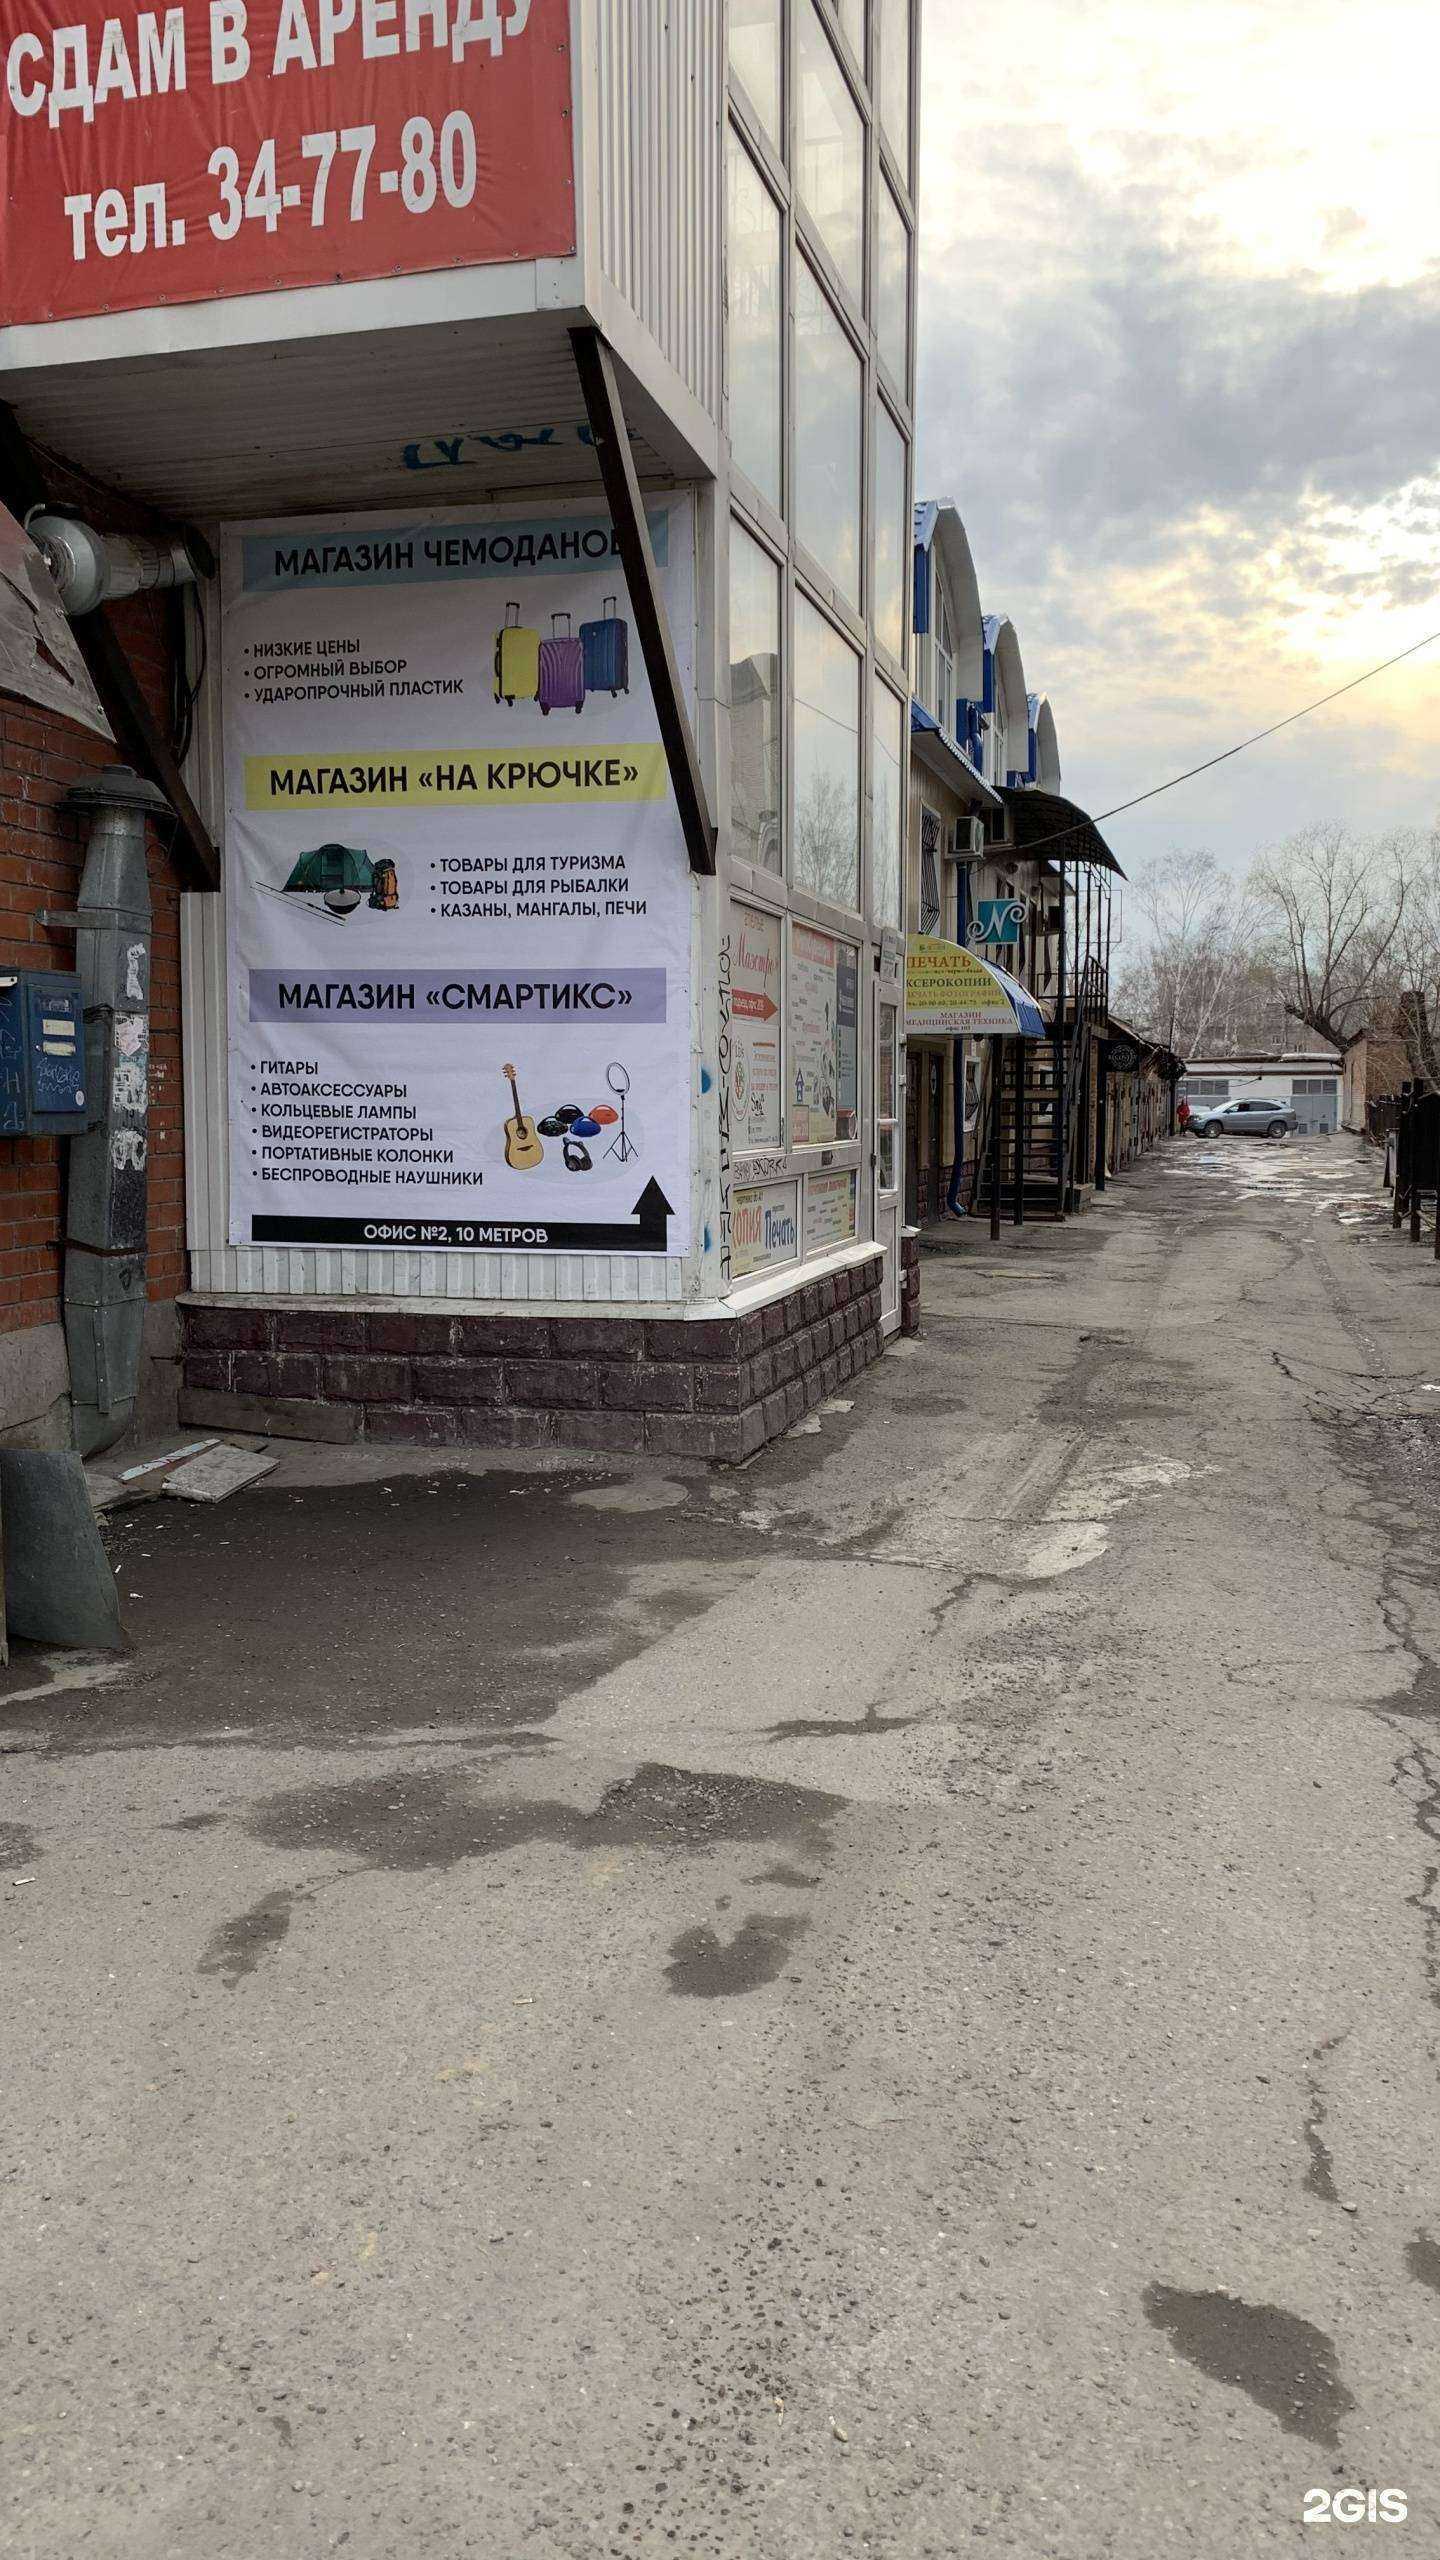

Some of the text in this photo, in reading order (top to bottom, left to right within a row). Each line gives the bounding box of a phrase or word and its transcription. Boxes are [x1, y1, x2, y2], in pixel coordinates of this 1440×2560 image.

[6, 6, 187, 129] СДАМ
[209, 0, 251, 84] В
[63, 109, 478, 261] тел. 34-77-80
[274, 540, 414, 577] МАГАЗИН
[253, 639, 360, 658] НИЗКИЕ ЦЕНЫ
[254, 659, 408, 680] ОГРОМНЫЙ ВЫБОР
[254, 679, 464, 704] УДАРОПРОЧНЫЙ ПЛАСТИК
[270, 758, 640, 796] МАГАЗИН «НА КРЮЧКЕ»
[440, 855, 626, 874] ТОВАРЫ ДЛЯ ТУРИЗМА
[440, 878, 629, 896] ТОВАРЫ ДЛЯ РЫБАЛКИ
[440, 900, 647, 919] КАЗАНЫ, МАНГАЛЫ, ПЕЧИ
[906, 956, 972, 969] ПЕЧАТЬ
[906, 978, 992, 988] КСЕРОКОПИИ
[278, 981, 633, 1010] МАГАЗИН «СМАРТИКС»
[940, 1011, 982, 1019] МАГАЗИН
[260, 1061, 318, 1075] ГИТАРЫ
[260, 1082, 407, 1098] АВТОАКСЕССУАРЫ
[261, 1103, 416, 1120] КОЛЬЦЕВЫЕ ЛАМПЫ
[262, 1124, 433, 1141] ВИДЕОРЕГИСТРАТОРЫ
[262, 1146, 454, 1163] ПОРТАТИВНЫЕ КОЛОНКИ
[261, 1167, 483, 1185] БЕСПРОВОДНЫЕ НАУШНИКИ
[364, 1224, 549, 1243] ОФИС №2, 10 МЕТРОВ
[765, 1210, 795, 1249] Печать
